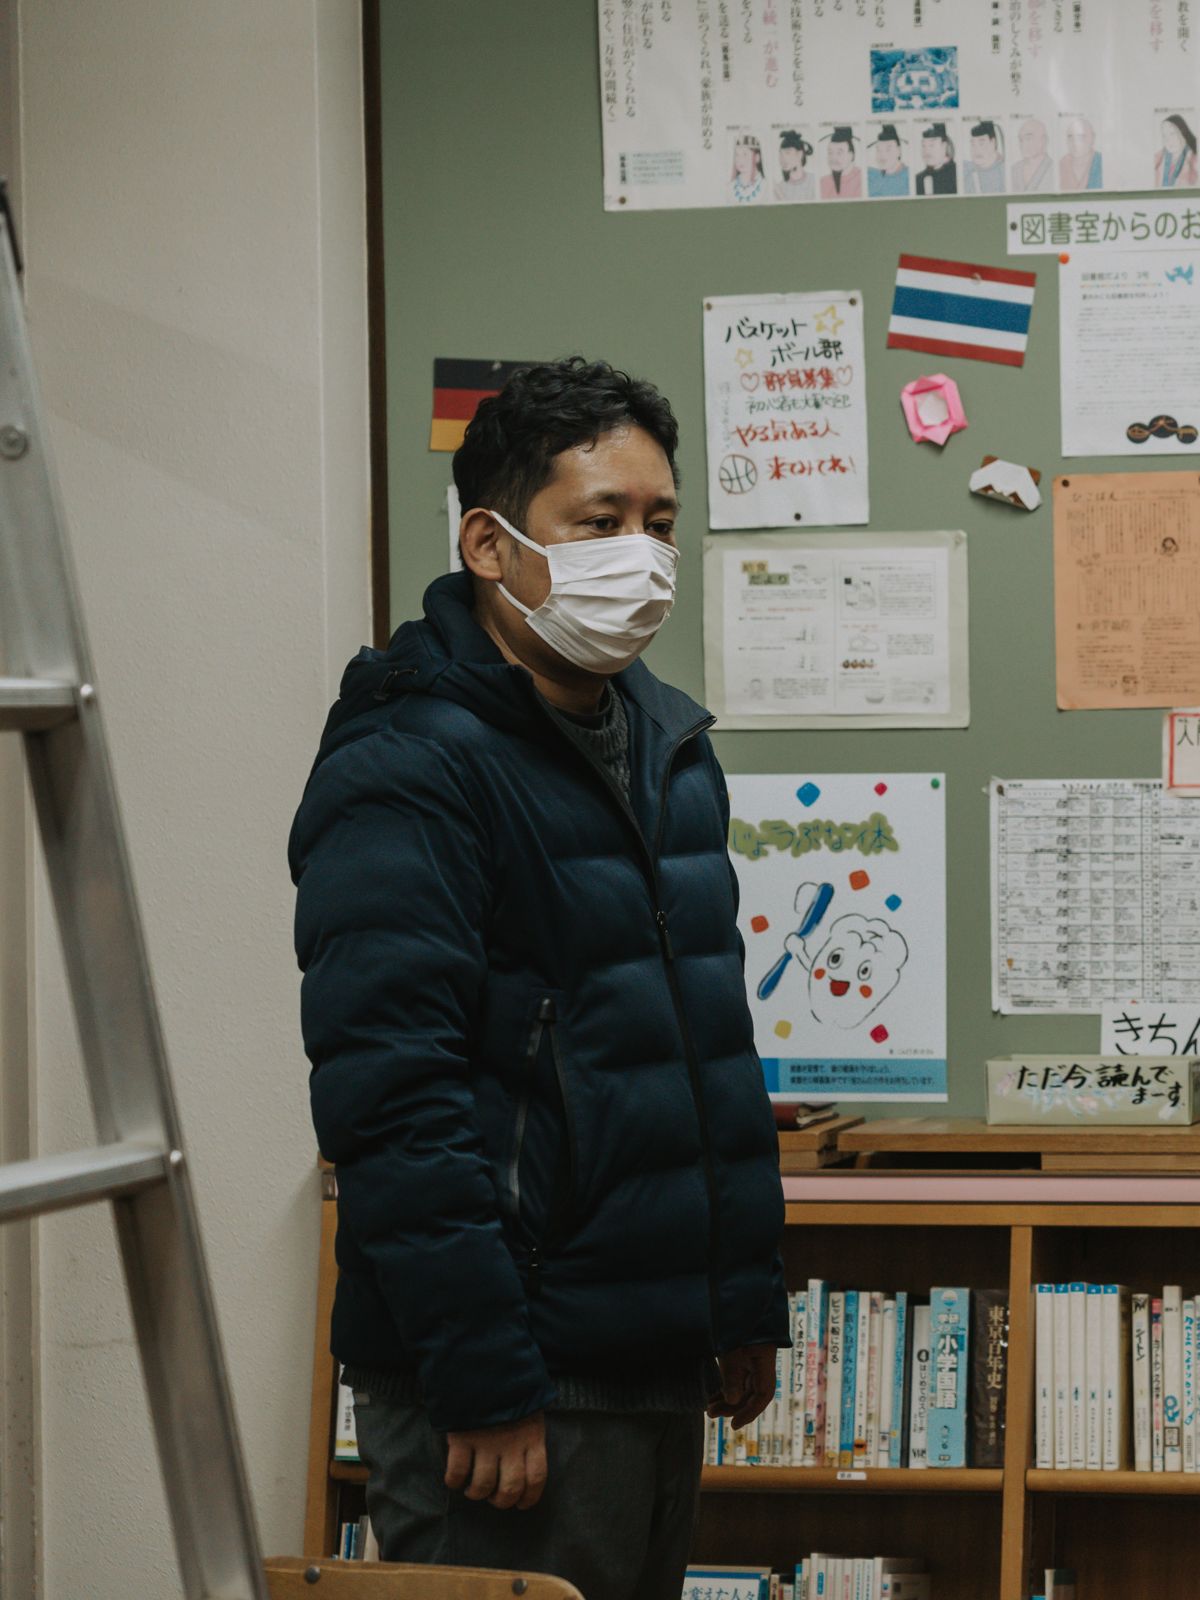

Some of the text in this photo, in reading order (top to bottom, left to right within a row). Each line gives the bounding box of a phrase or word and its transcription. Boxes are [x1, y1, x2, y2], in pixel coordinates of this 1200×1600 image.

[725, 316, 808, 344] バスケット
[771, 337, 844, 367] ボール部
[762, 366, 836, 391] 部員募集
